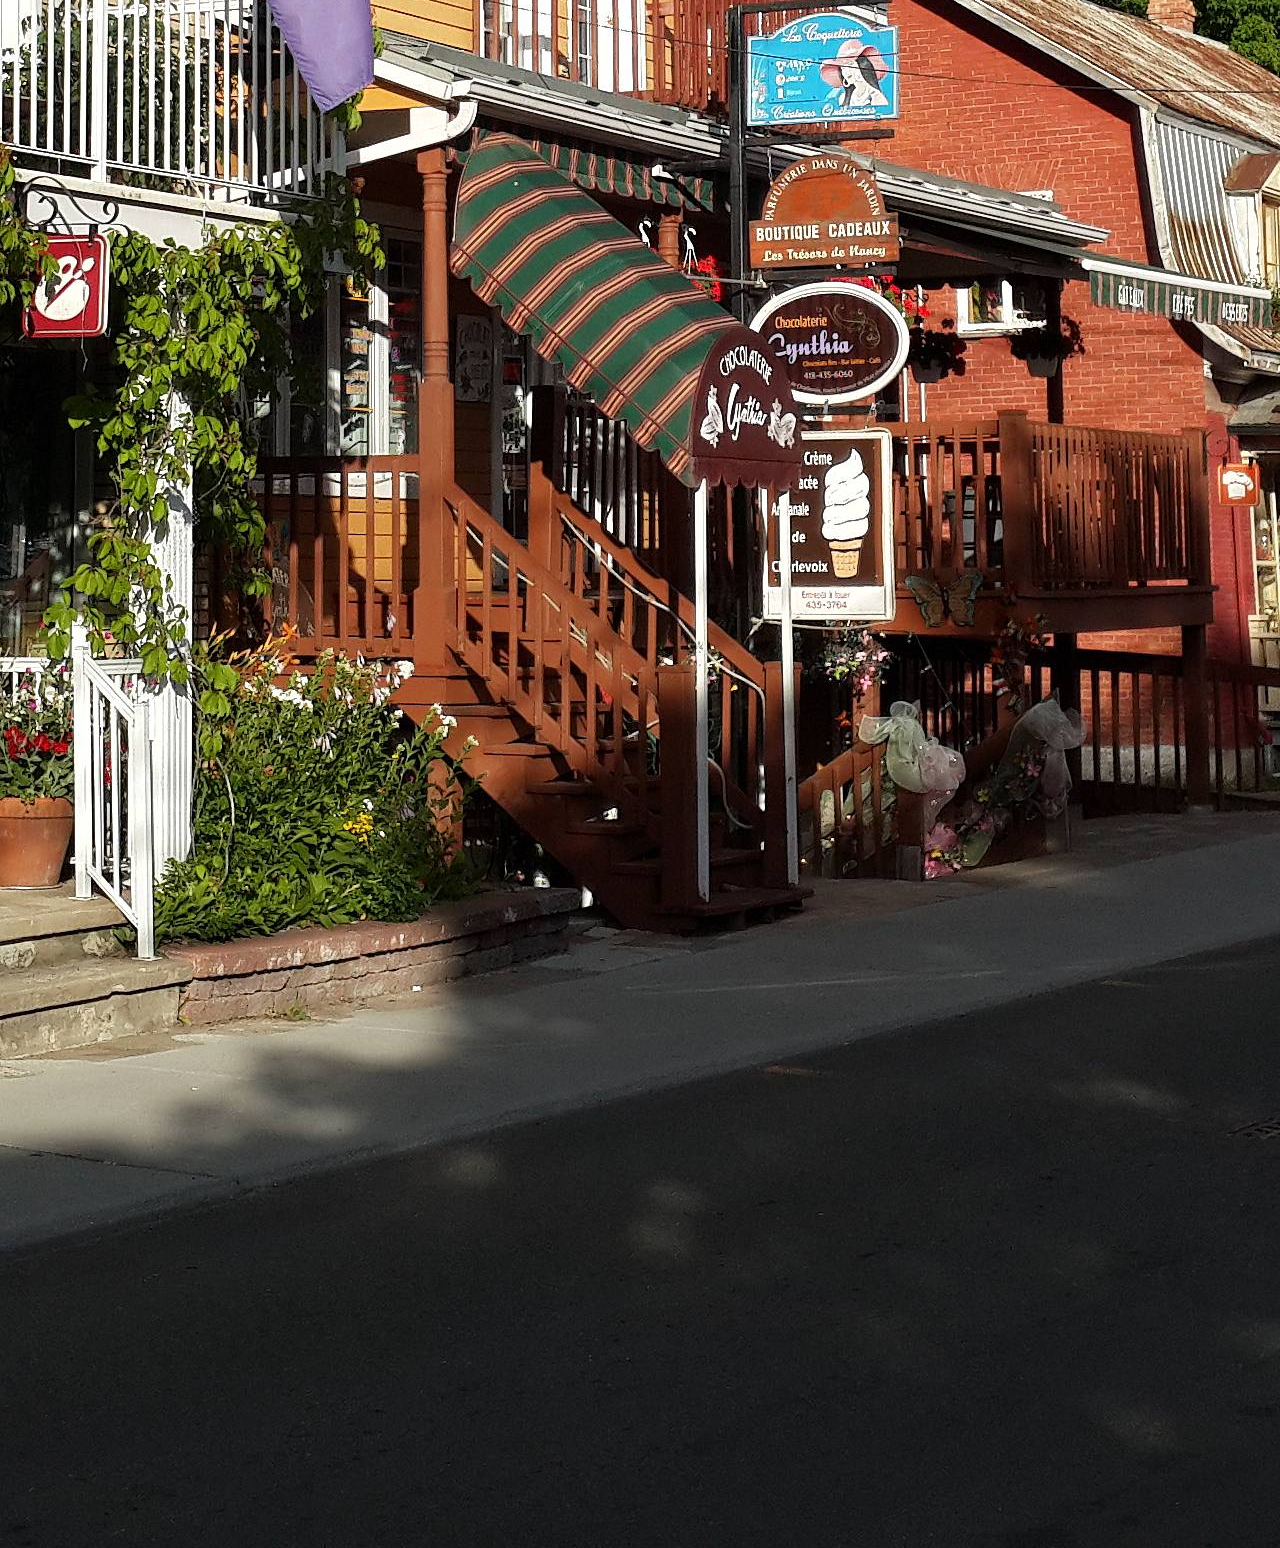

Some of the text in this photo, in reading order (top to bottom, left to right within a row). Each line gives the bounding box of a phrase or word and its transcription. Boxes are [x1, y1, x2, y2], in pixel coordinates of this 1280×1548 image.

[781, 25, 802, 43] La
[764, 158, 881, 221] PARFUMERIE DANS UN JARDIN
[756, 220, 891, 242] BOUTIQUE CADEAUX
[762, 244, 886, 262] Les Trésors de Nancy
[775, 315, 828, 329] Chocolaterie
[767, 329, 854, 364] Cynthia
[720, 345, 773, 386] CHOCOLATERIE
[726, 383, 768, 441] Cynthia
[803, 450, 833, 466] Crème
[771, 502, 810, 517] Aranale
[791, 530, 807, 544] de
[771, 561, 829, 574] Crlevoix
